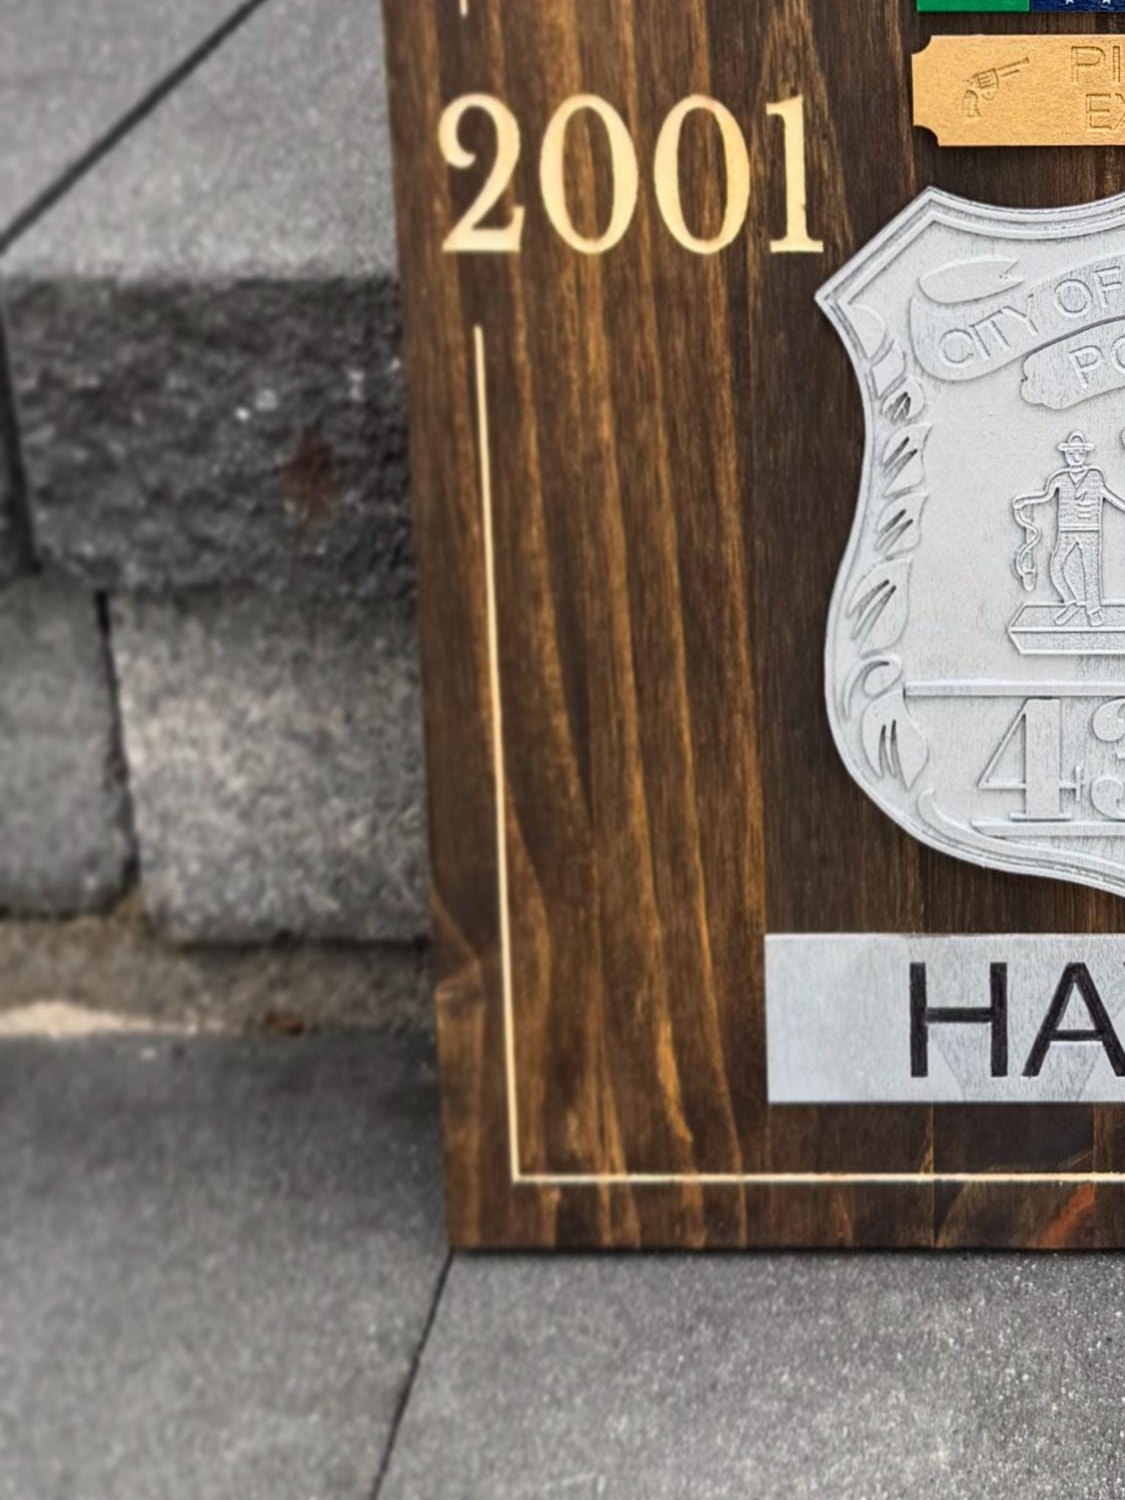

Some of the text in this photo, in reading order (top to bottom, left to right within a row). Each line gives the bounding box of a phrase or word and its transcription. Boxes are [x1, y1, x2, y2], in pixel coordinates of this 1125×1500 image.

[438, 93, 824, 254] 2001
[937, 293, 1039, 369] CITY
[1053, 265, 1122, 318] OF
